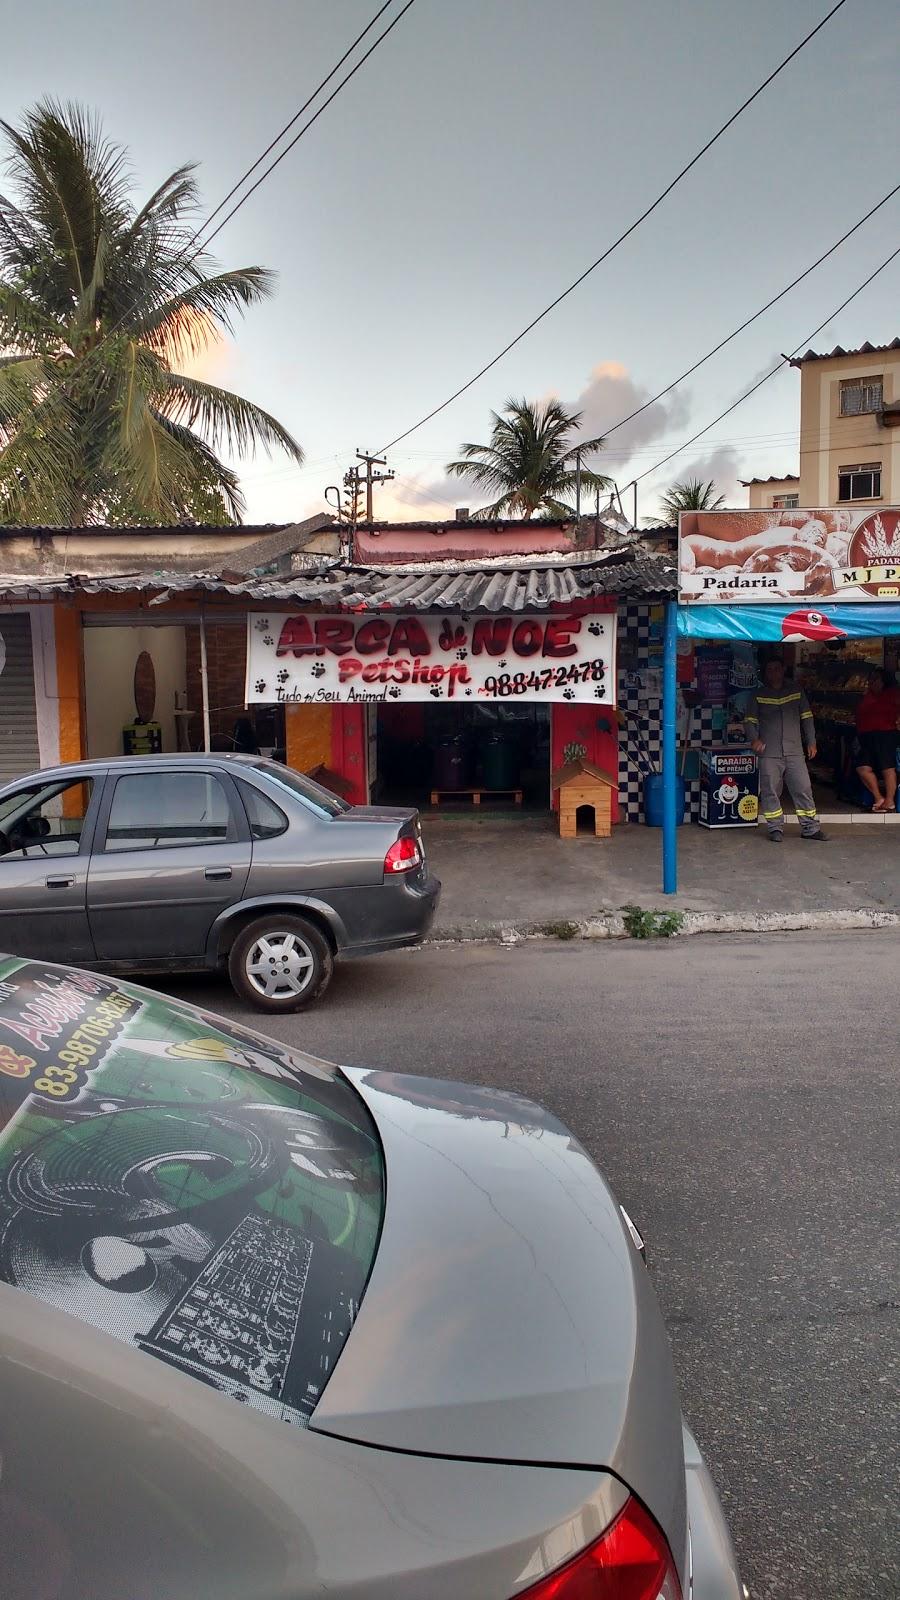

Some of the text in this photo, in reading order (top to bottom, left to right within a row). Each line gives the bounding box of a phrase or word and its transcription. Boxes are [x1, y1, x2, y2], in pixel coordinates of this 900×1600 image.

[703, 576, 779, 589] Padaria
[275, 613, 589, 657] ARCA de NOÉ
[338, 658, 472, 697] PetShop
[347, 685, 388, 702] Animal
[484, 659, 605, 697] 988472478
[34, 991, 135, 1096] 83-98706-8267
